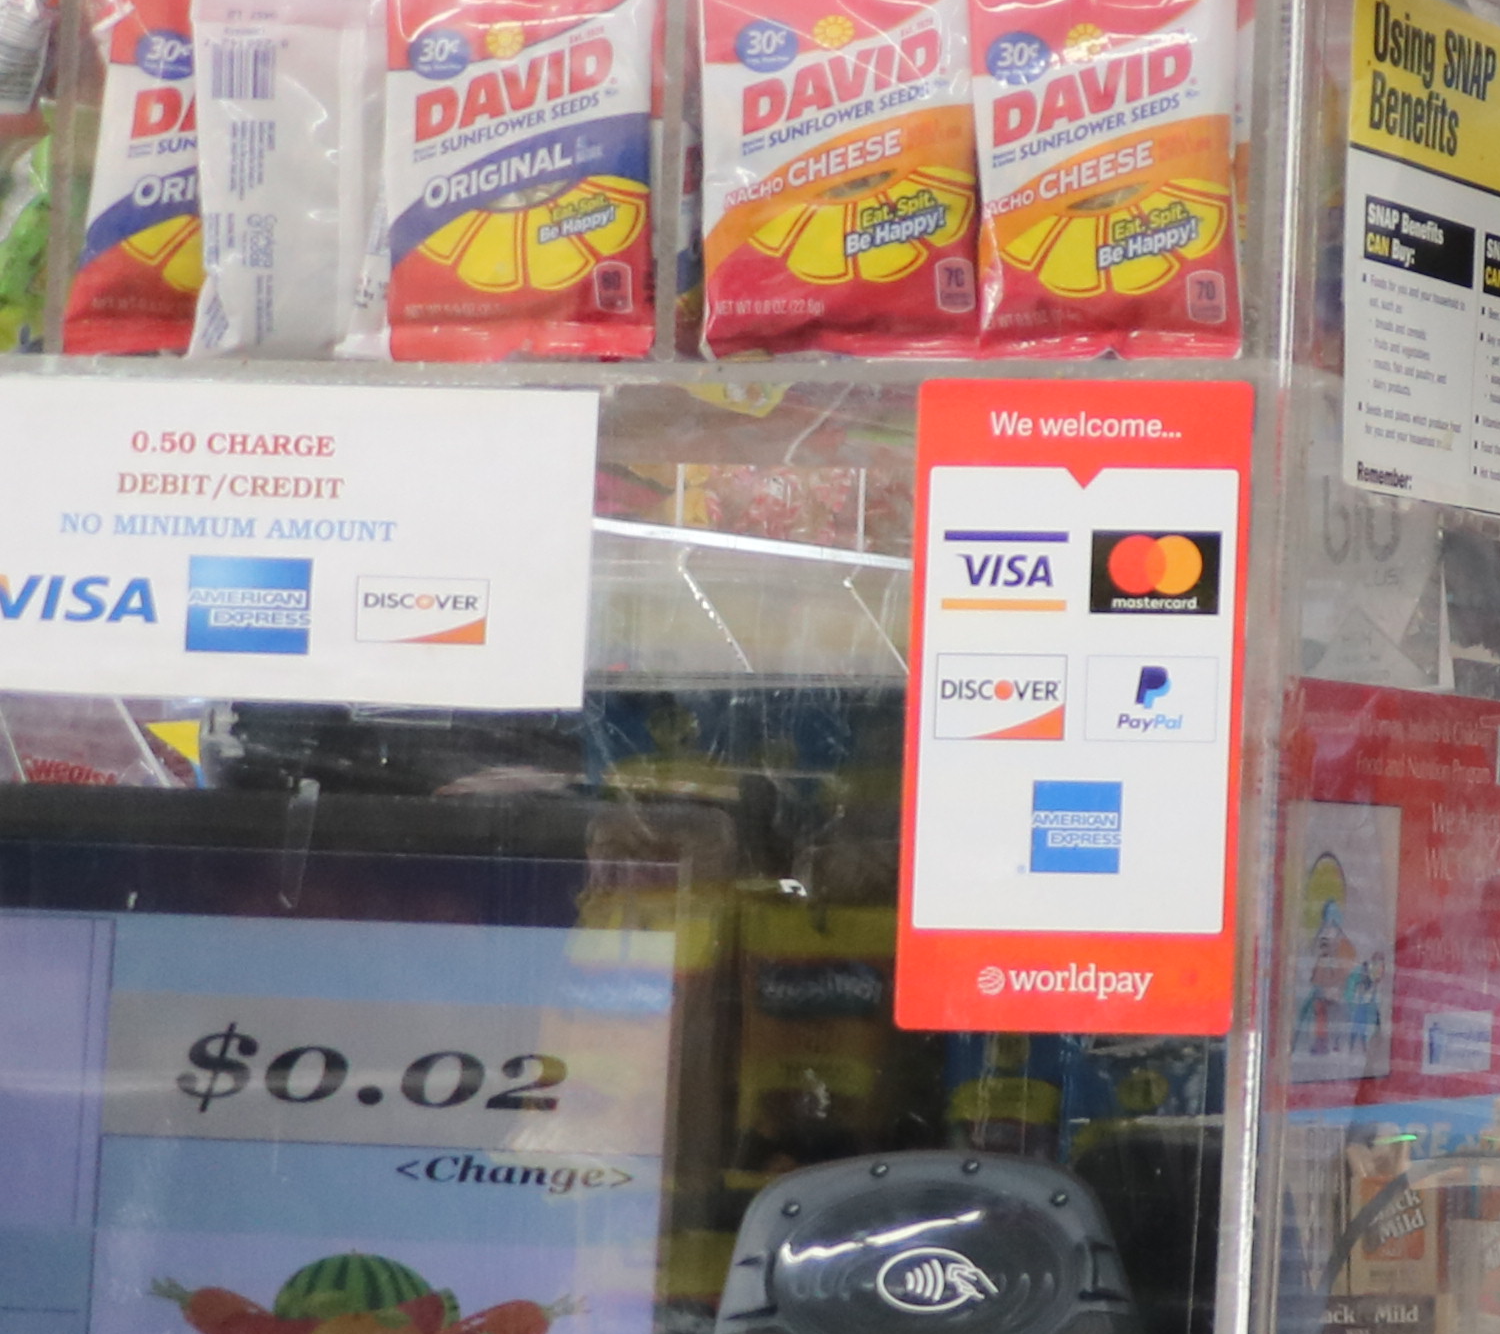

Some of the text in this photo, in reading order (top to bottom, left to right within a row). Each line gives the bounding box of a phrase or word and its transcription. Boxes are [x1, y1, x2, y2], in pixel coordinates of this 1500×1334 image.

[1373, 0, 1498, 103] Using SNAP
[415, 36, 616, 144] DAVID
[439, 91, 600, 156] SUNFLOWER SEEDS
[1368, 72, 1460, 158] Benefits
[788, 130, 902, 187] CHEESE
[424, 141, 571, 209] ORIGINAL
[990, 412, 1034, 438] We
[131, 431, 335, 458] 0.50 CHARGE
[118, 472, 345, 500] DEBIT/CREDIT
[59, 513, 396, 543] NO MINIMUM AMOUNT
[957, 553, 1054, 588] VISA
[0, 576, 158, 623] VISA
[188, 589, 304, 607] AMERICAN
[364, 591, 479, 613] DISCOVER
[1111, 595, 1198, 611] mastercard
[211, 610, 312, 627] EXPRESS
[941, 679, 1060, 703] DISCOVER
[1117, 713, 1183, 733] PayPal
[1009, 966, 1153, 1015] worldpay
[175, 1023, 568, 1112] $0.02
